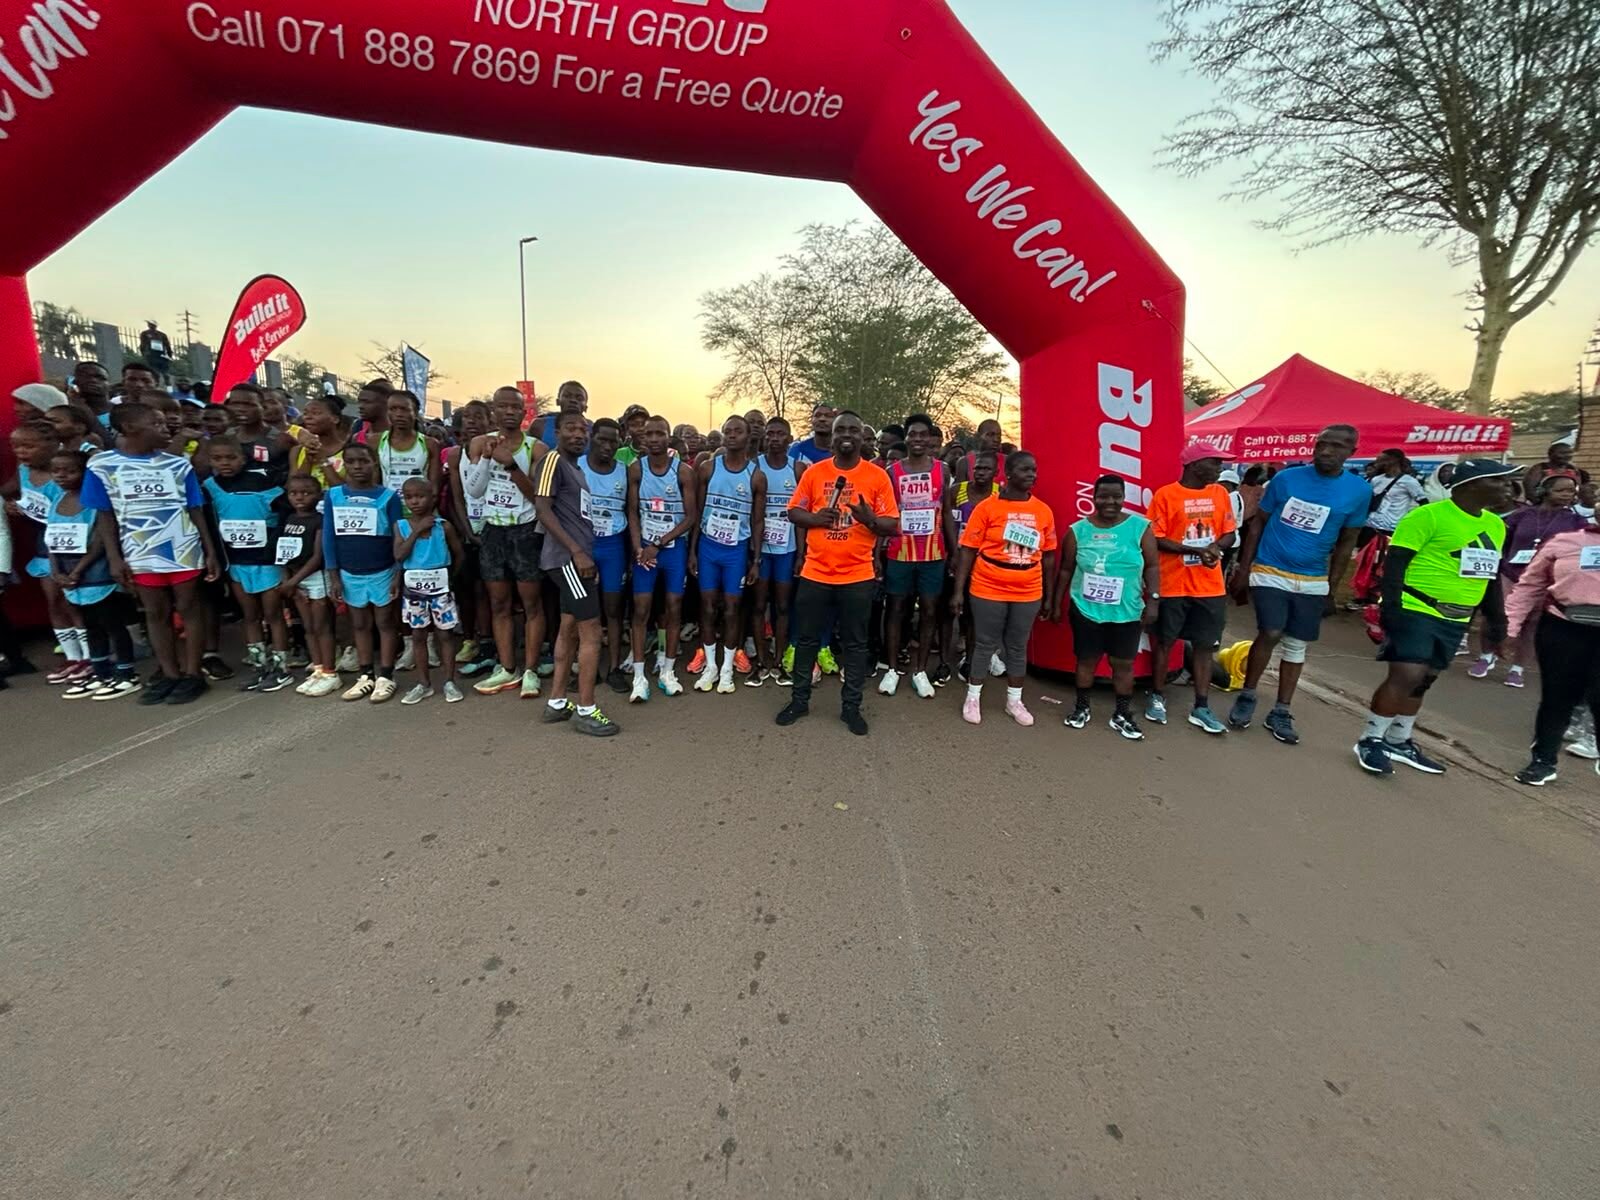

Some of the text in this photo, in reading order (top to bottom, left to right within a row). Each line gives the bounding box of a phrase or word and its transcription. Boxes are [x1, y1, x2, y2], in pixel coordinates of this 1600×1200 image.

[474, 0, 768, 57] NORTH GROUP
[186, 2, 843, 119] Call 071 888 7869 For a Free Quote
[909, 89, 1117, 303] Yes We Can!
[233, 293, 290, 346] Build it
[1098, 362, 1154, 517] Bui
[1405, 425, 1504, 444] Build it
[1244, 437, 1264, 446] Call
[1266, 435, 1285, 445] 071
[1243, 449, 1260, 458] For
[1273, 447, 1296, 457] Free
[1298, 446, 1314, 456] Qu
[134, 483, 164, 493] 860
[907, 482, 930, 495] 4714
[493, 494, 513, 504] 857
[1076, 481, 1096, 519] NO
[343, 520, 364, 528] 867
[1289, 513, 1316, 526] 672
[908, 522, 929, 530] 675
[230, 533, 255, 541] 862
[713, 529, 733, 541] 785
[764, 531, 784, 540] 685
[826, 531, 849, 540] 2026
[1473, 562, 1494, 571] 819
[416, 582, 436, 590] 861
[1090, 588, 1115, 599] 758
